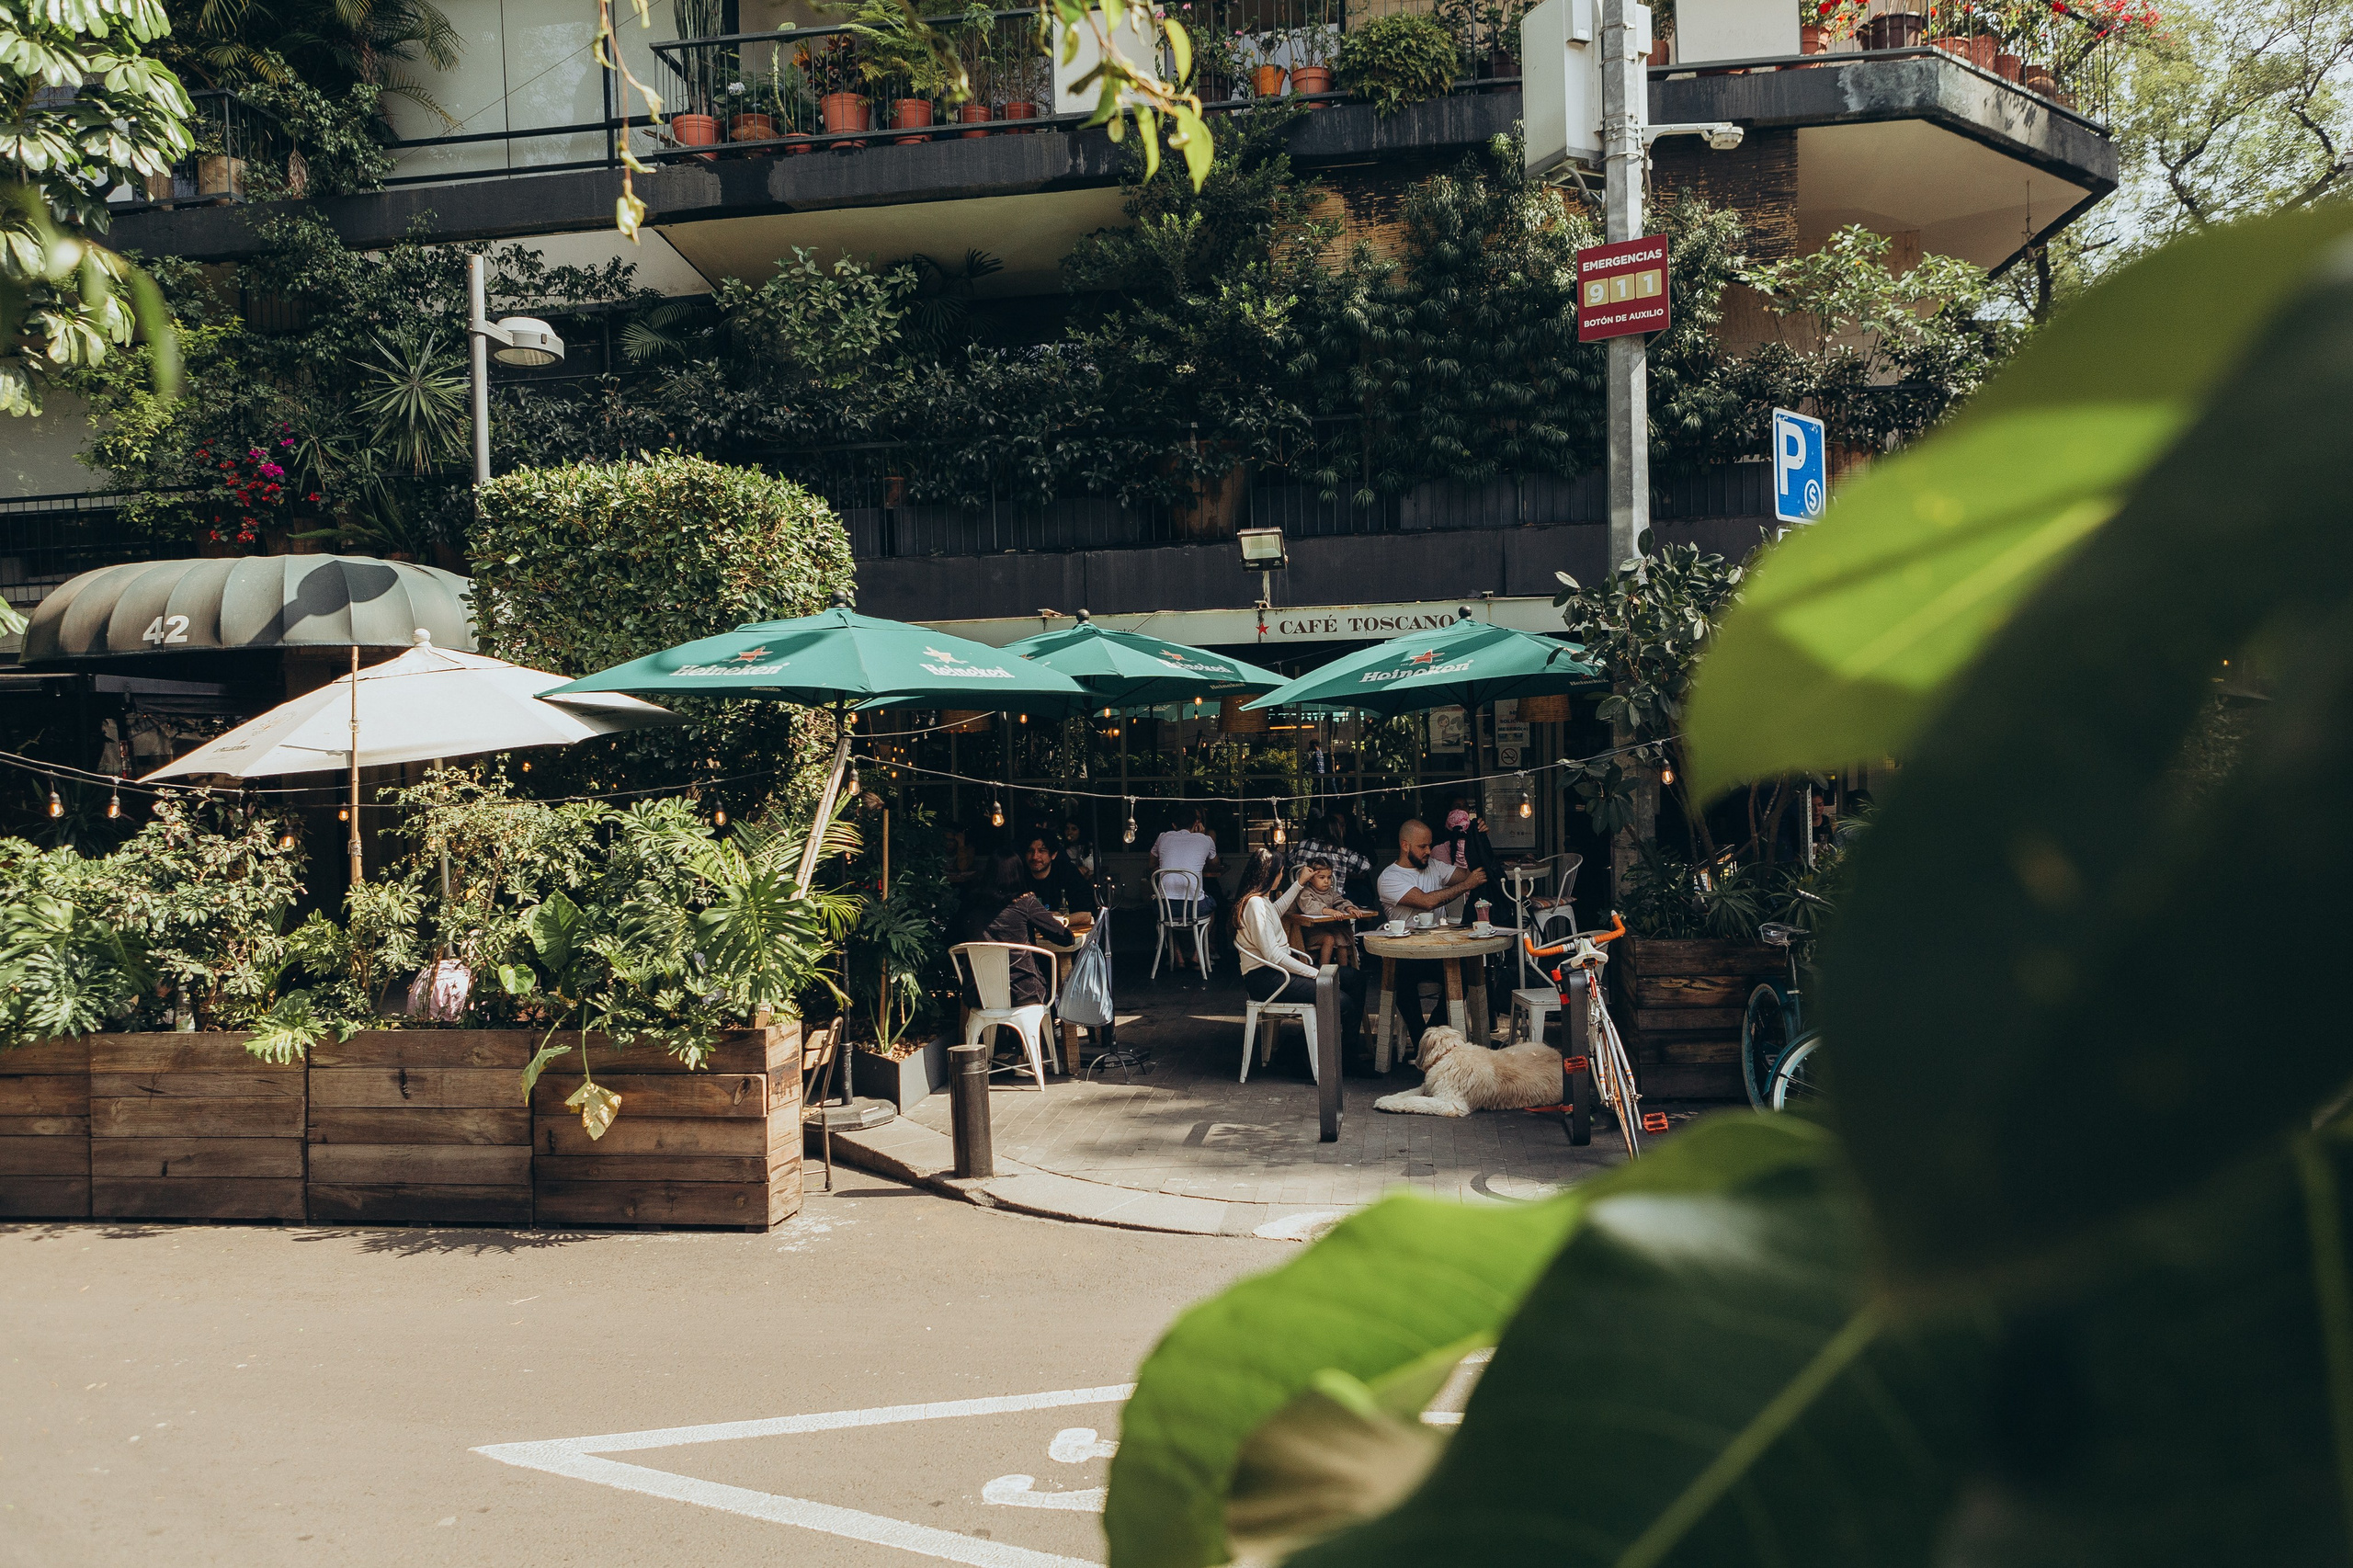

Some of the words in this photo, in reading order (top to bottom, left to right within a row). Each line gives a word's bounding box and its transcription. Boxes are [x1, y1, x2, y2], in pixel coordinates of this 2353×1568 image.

[1582, 248, 1663, 272] EMERGENCIAS
[1584, 315, 1613, 328] BOTÓN
[1615, 313, 1627, 323] DE
[1629, 308, 1664, 321] AUXILIO
[1779, 420, 1806, 496] P
[142, 615, 189, 644] 42
[1279, 614, 1337, 635] CAFÉ
[1348, 614, 1455, 633] TOSCANO
[669, 664, 784, 676] Heineken
[1358, 662, 1470, 683] Heineken
